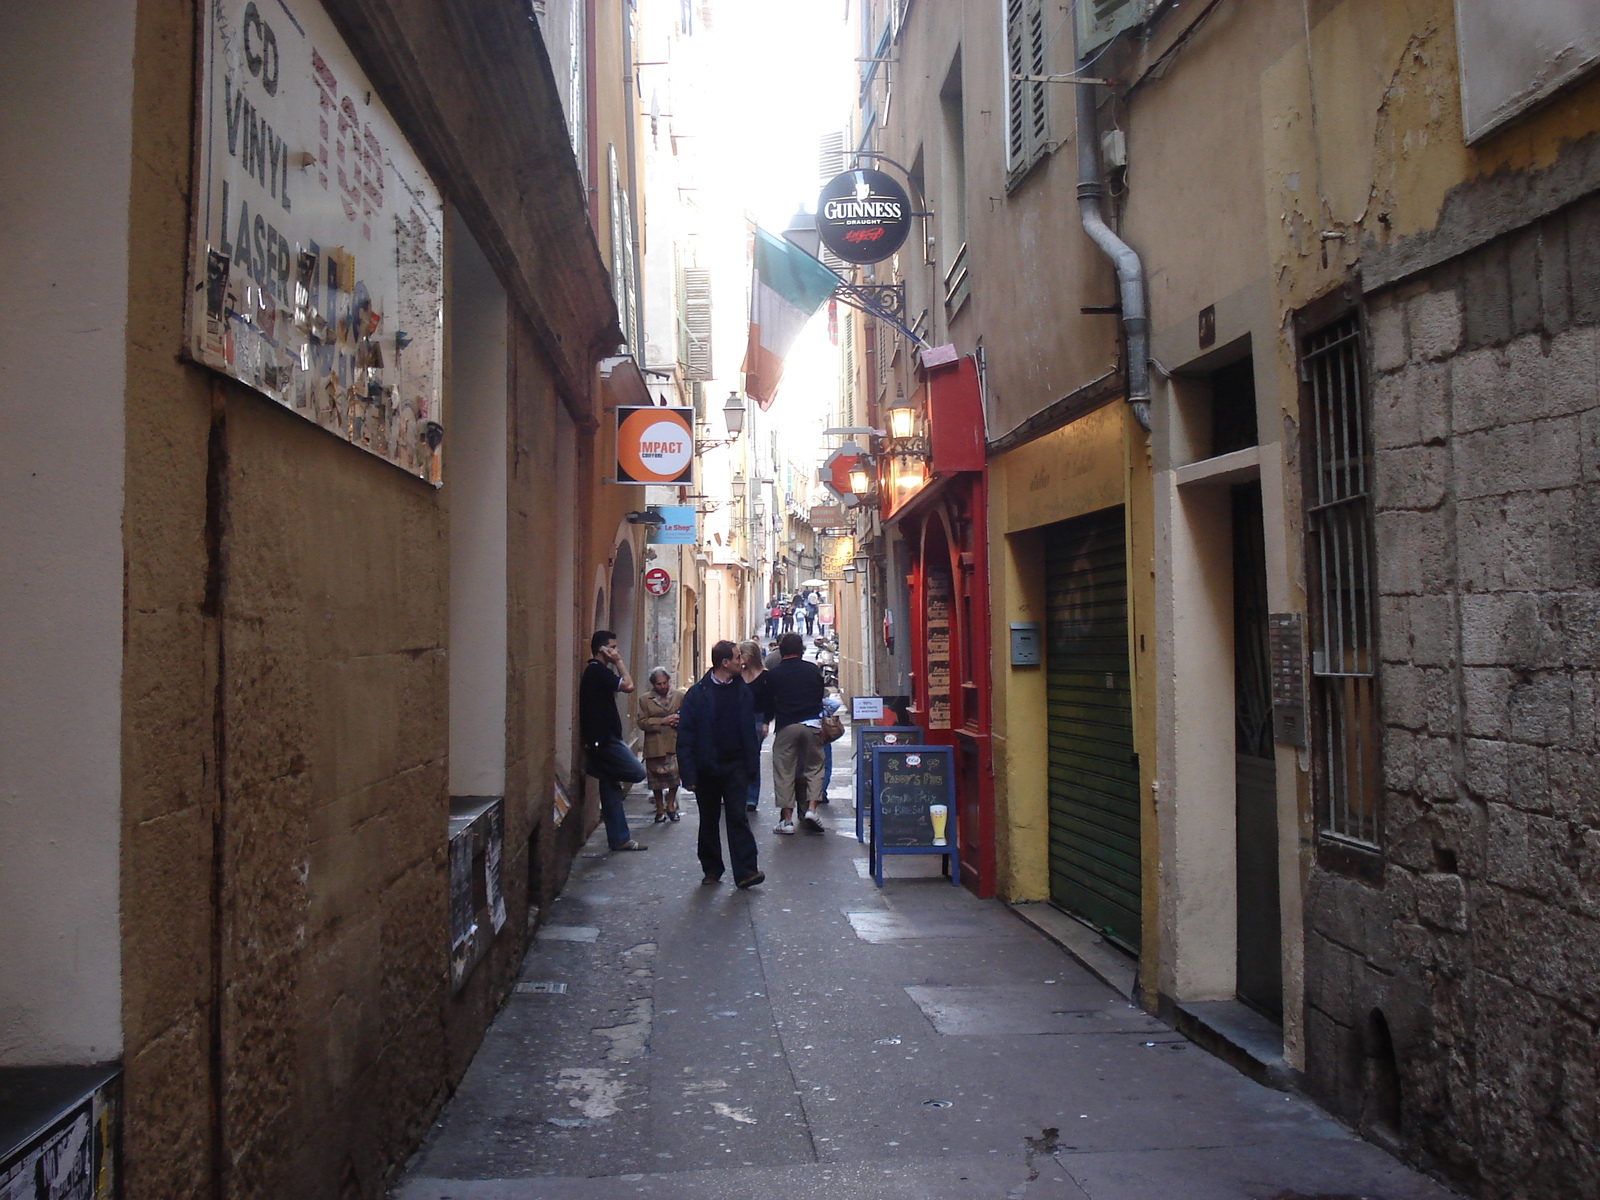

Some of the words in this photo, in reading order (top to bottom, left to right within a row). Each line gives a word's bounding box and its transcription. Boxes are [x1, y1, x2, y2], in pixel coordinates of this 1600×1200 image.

[243, 2, 280, 98] CD
[224, 73, 291, 215] VINYL
[824, 201, 902, 220] GUINNESS
[219, 179, 290, 309] LASER
[639, 442, 683, 454] IMPACT
[673, 524, 690, 532] Shop
